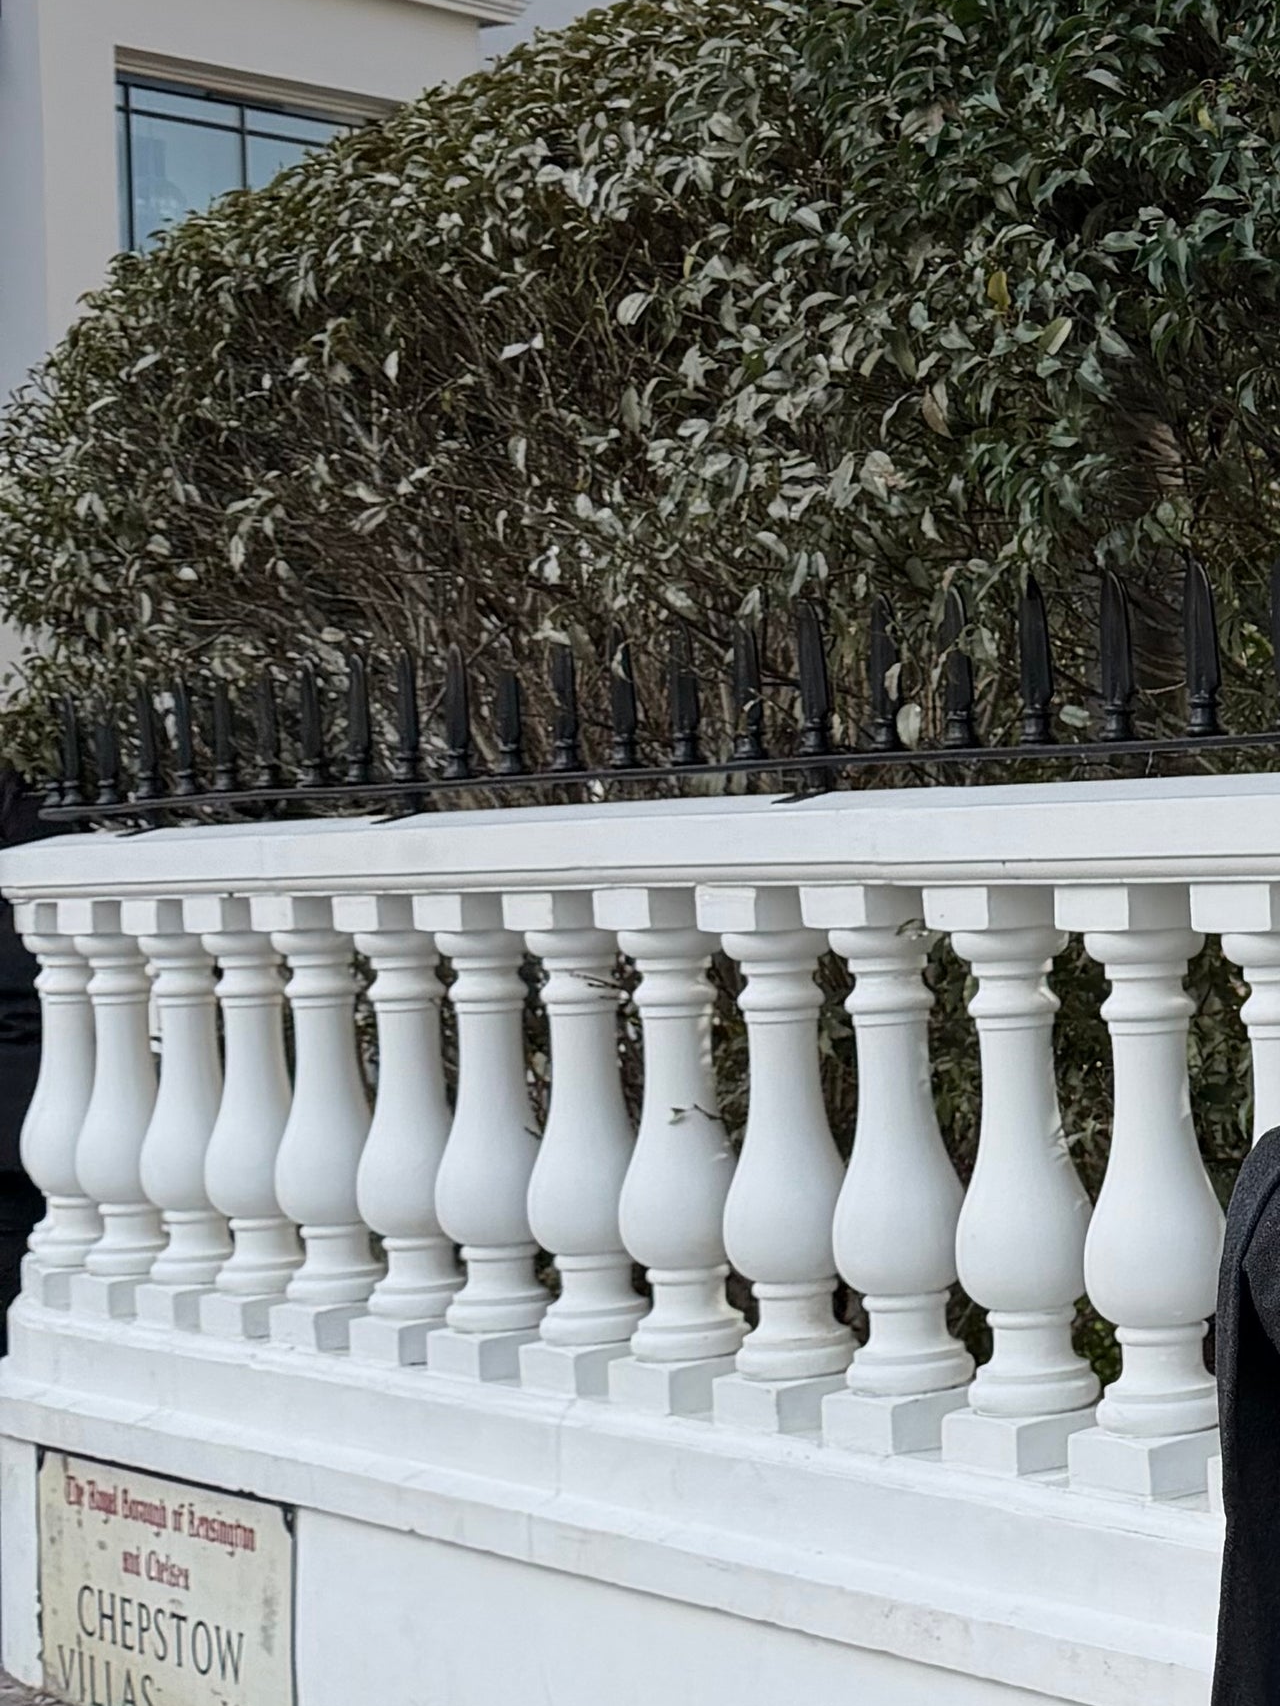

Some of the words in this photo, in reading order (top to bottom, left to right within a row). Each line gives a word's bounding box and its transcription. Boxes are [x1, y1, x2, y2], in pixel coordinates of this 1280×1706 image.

[122, 1488, 166, 1537] Borough
[172, 1503, 186, 1532] of
[187, 1502, 256, 1557] Kensington
[122, 1545, 141, 1576] and
[146, 1549, 190, 1591] Chelsea
[77, 1585, 244, 1685] CHEPSTOW
